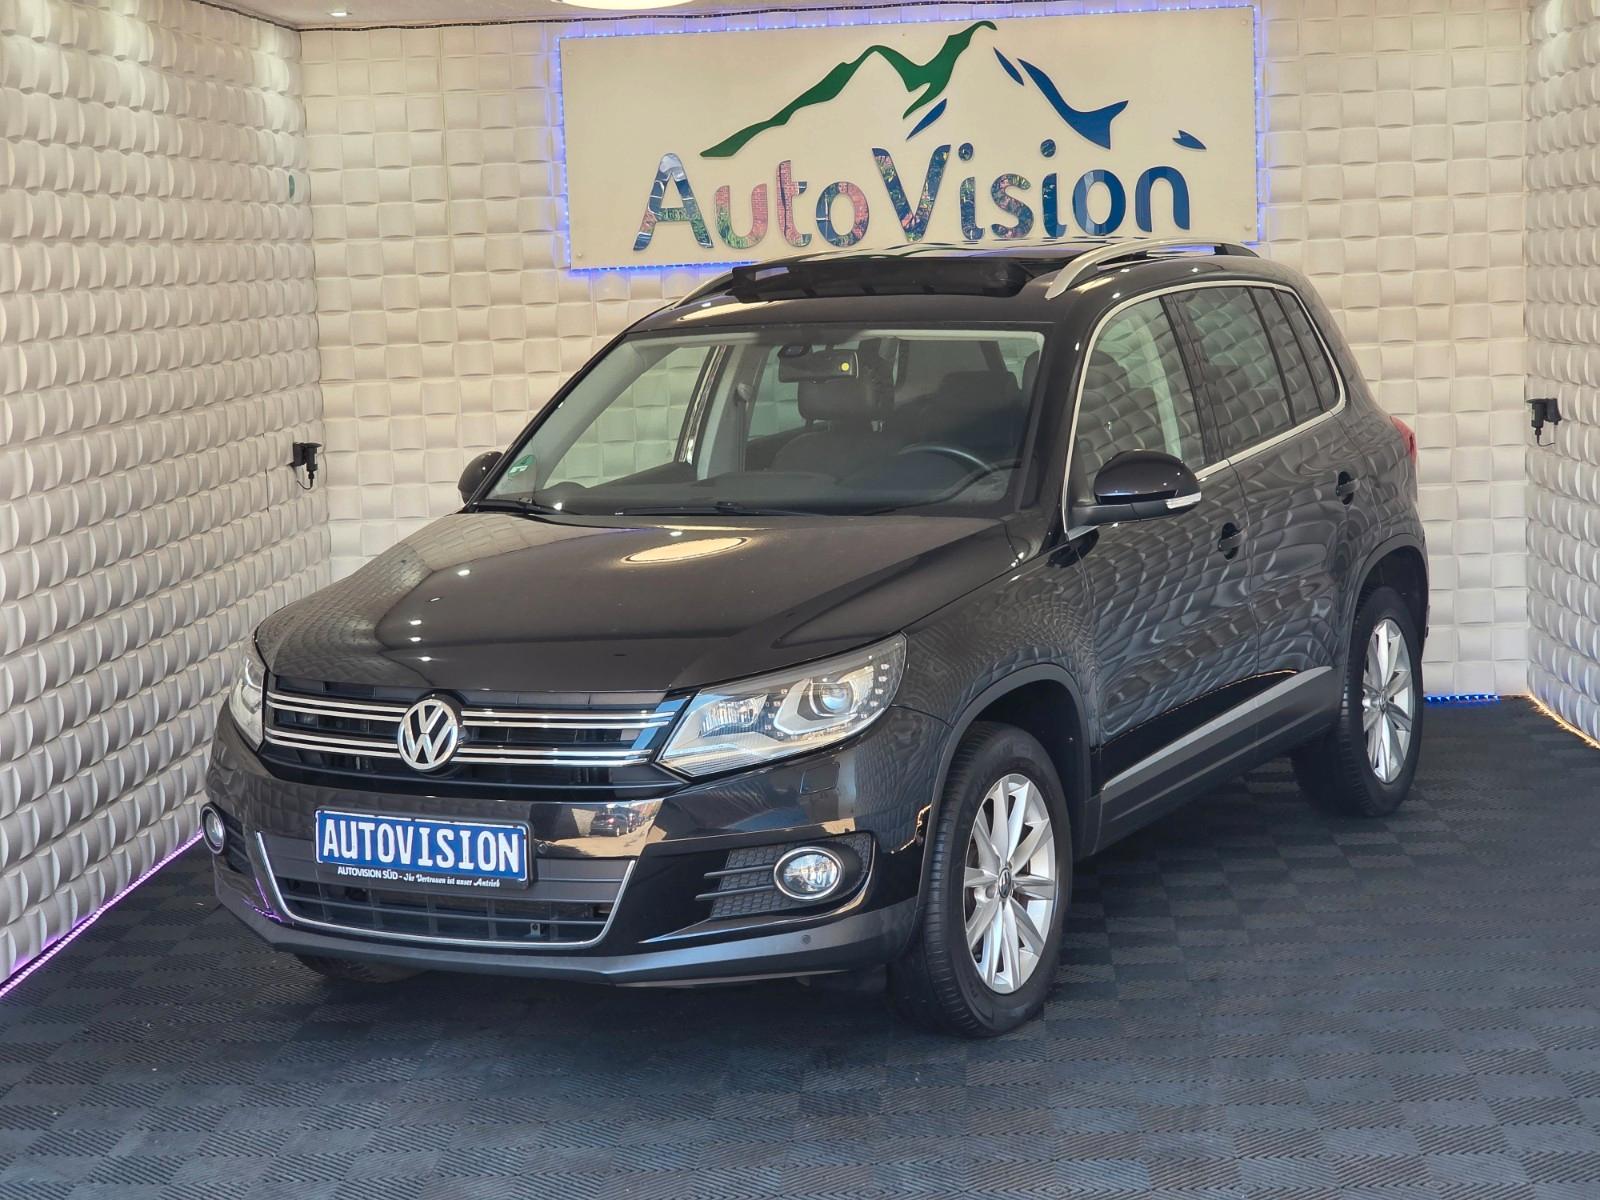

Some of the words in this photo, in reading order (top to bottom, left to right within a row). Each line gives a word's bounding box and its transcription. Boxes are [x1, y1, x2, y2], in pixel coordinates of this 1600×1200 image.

[633, 139, 1191, 252] AutoVision
[398, 699, 458, 769] VW
[323, 818, 520, 873] AUTOVISION
[337, 866, 382, 879] AUTOVISION
[382, 868, 398, 880] SÜD
[447, 876, 455, 885] ist
